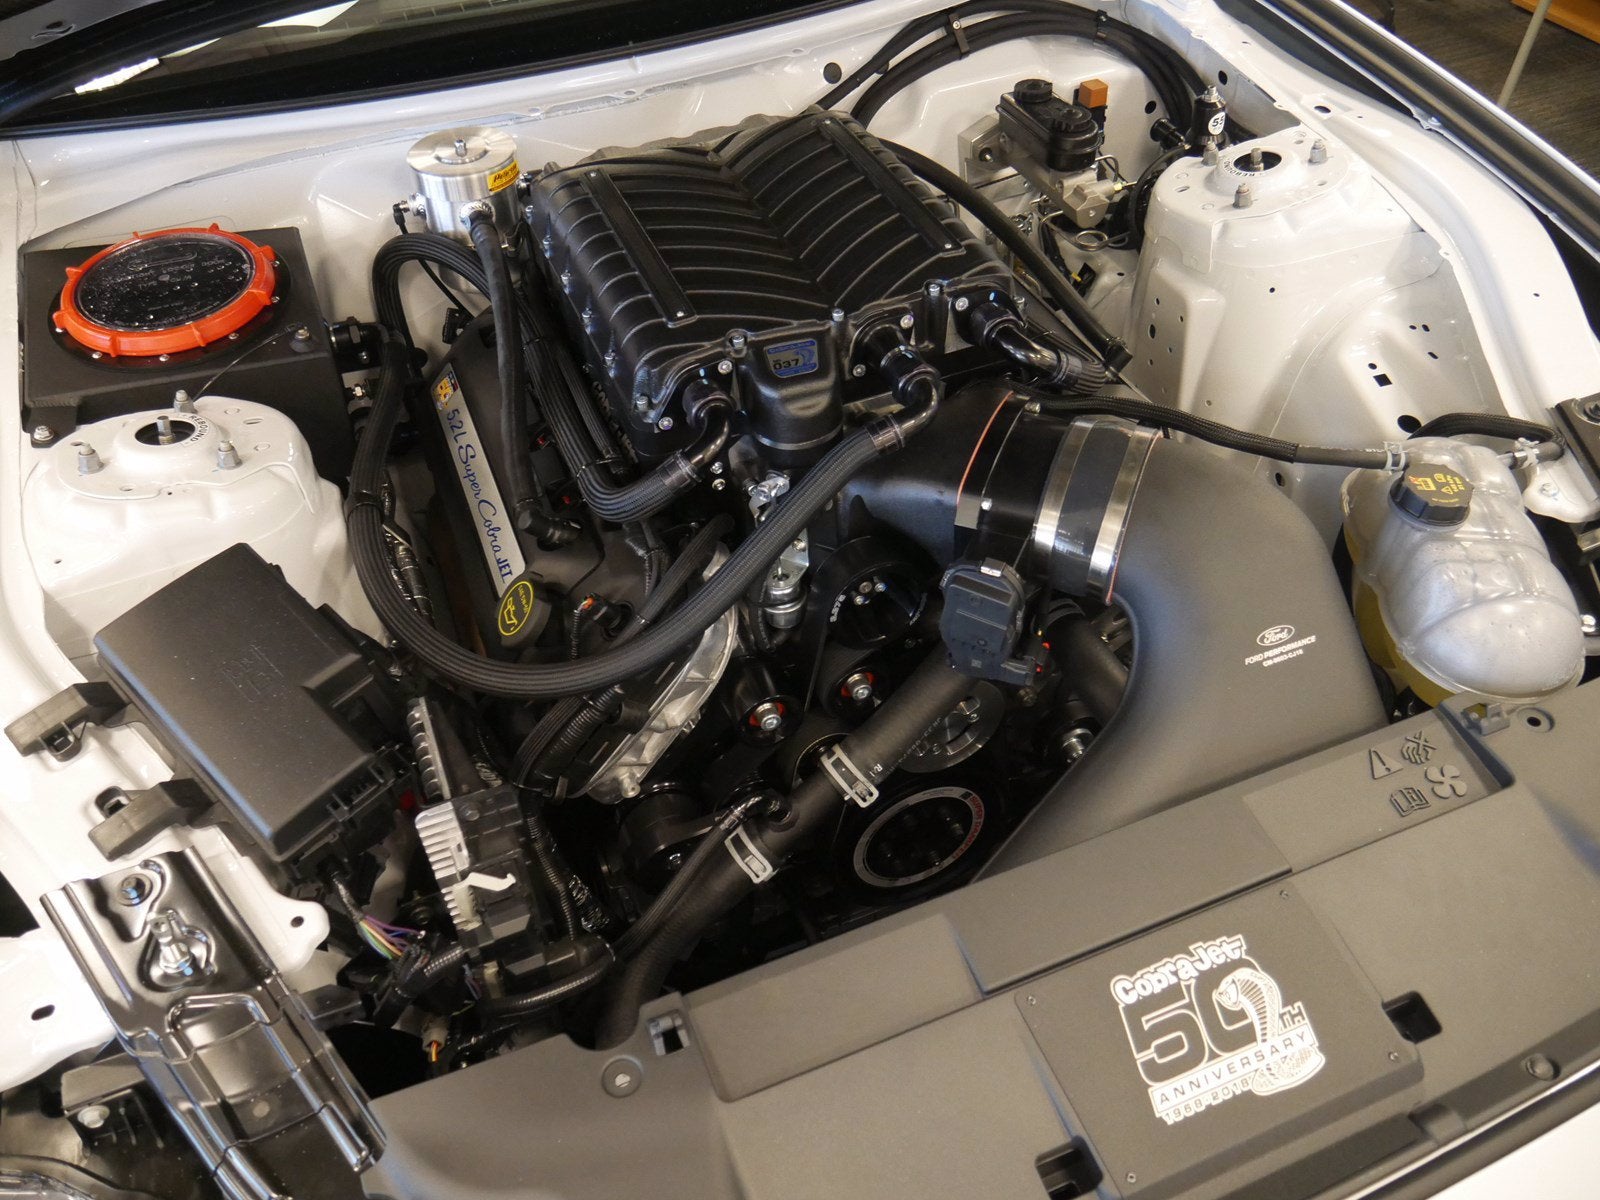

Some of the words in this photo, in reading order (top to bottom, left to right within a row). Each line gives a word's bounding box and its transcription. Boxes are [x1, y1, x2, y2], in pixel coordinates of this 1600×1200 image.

[773, 358, 799, 370] 037
[189, 415, 209, 442] REBOUND
[457, 443, 481, 499] Super
[477, 499, 502, 554] Cobra
[497, 556, 514, 584] JET
[1244, 653, 1264, 665] FORD
[1263, 635, 1316, 659] PERFORMANCE
[1263, 628, 1289, 644] Ford
[1159, 1030, 1308, 1105] ANNIVERSARY
